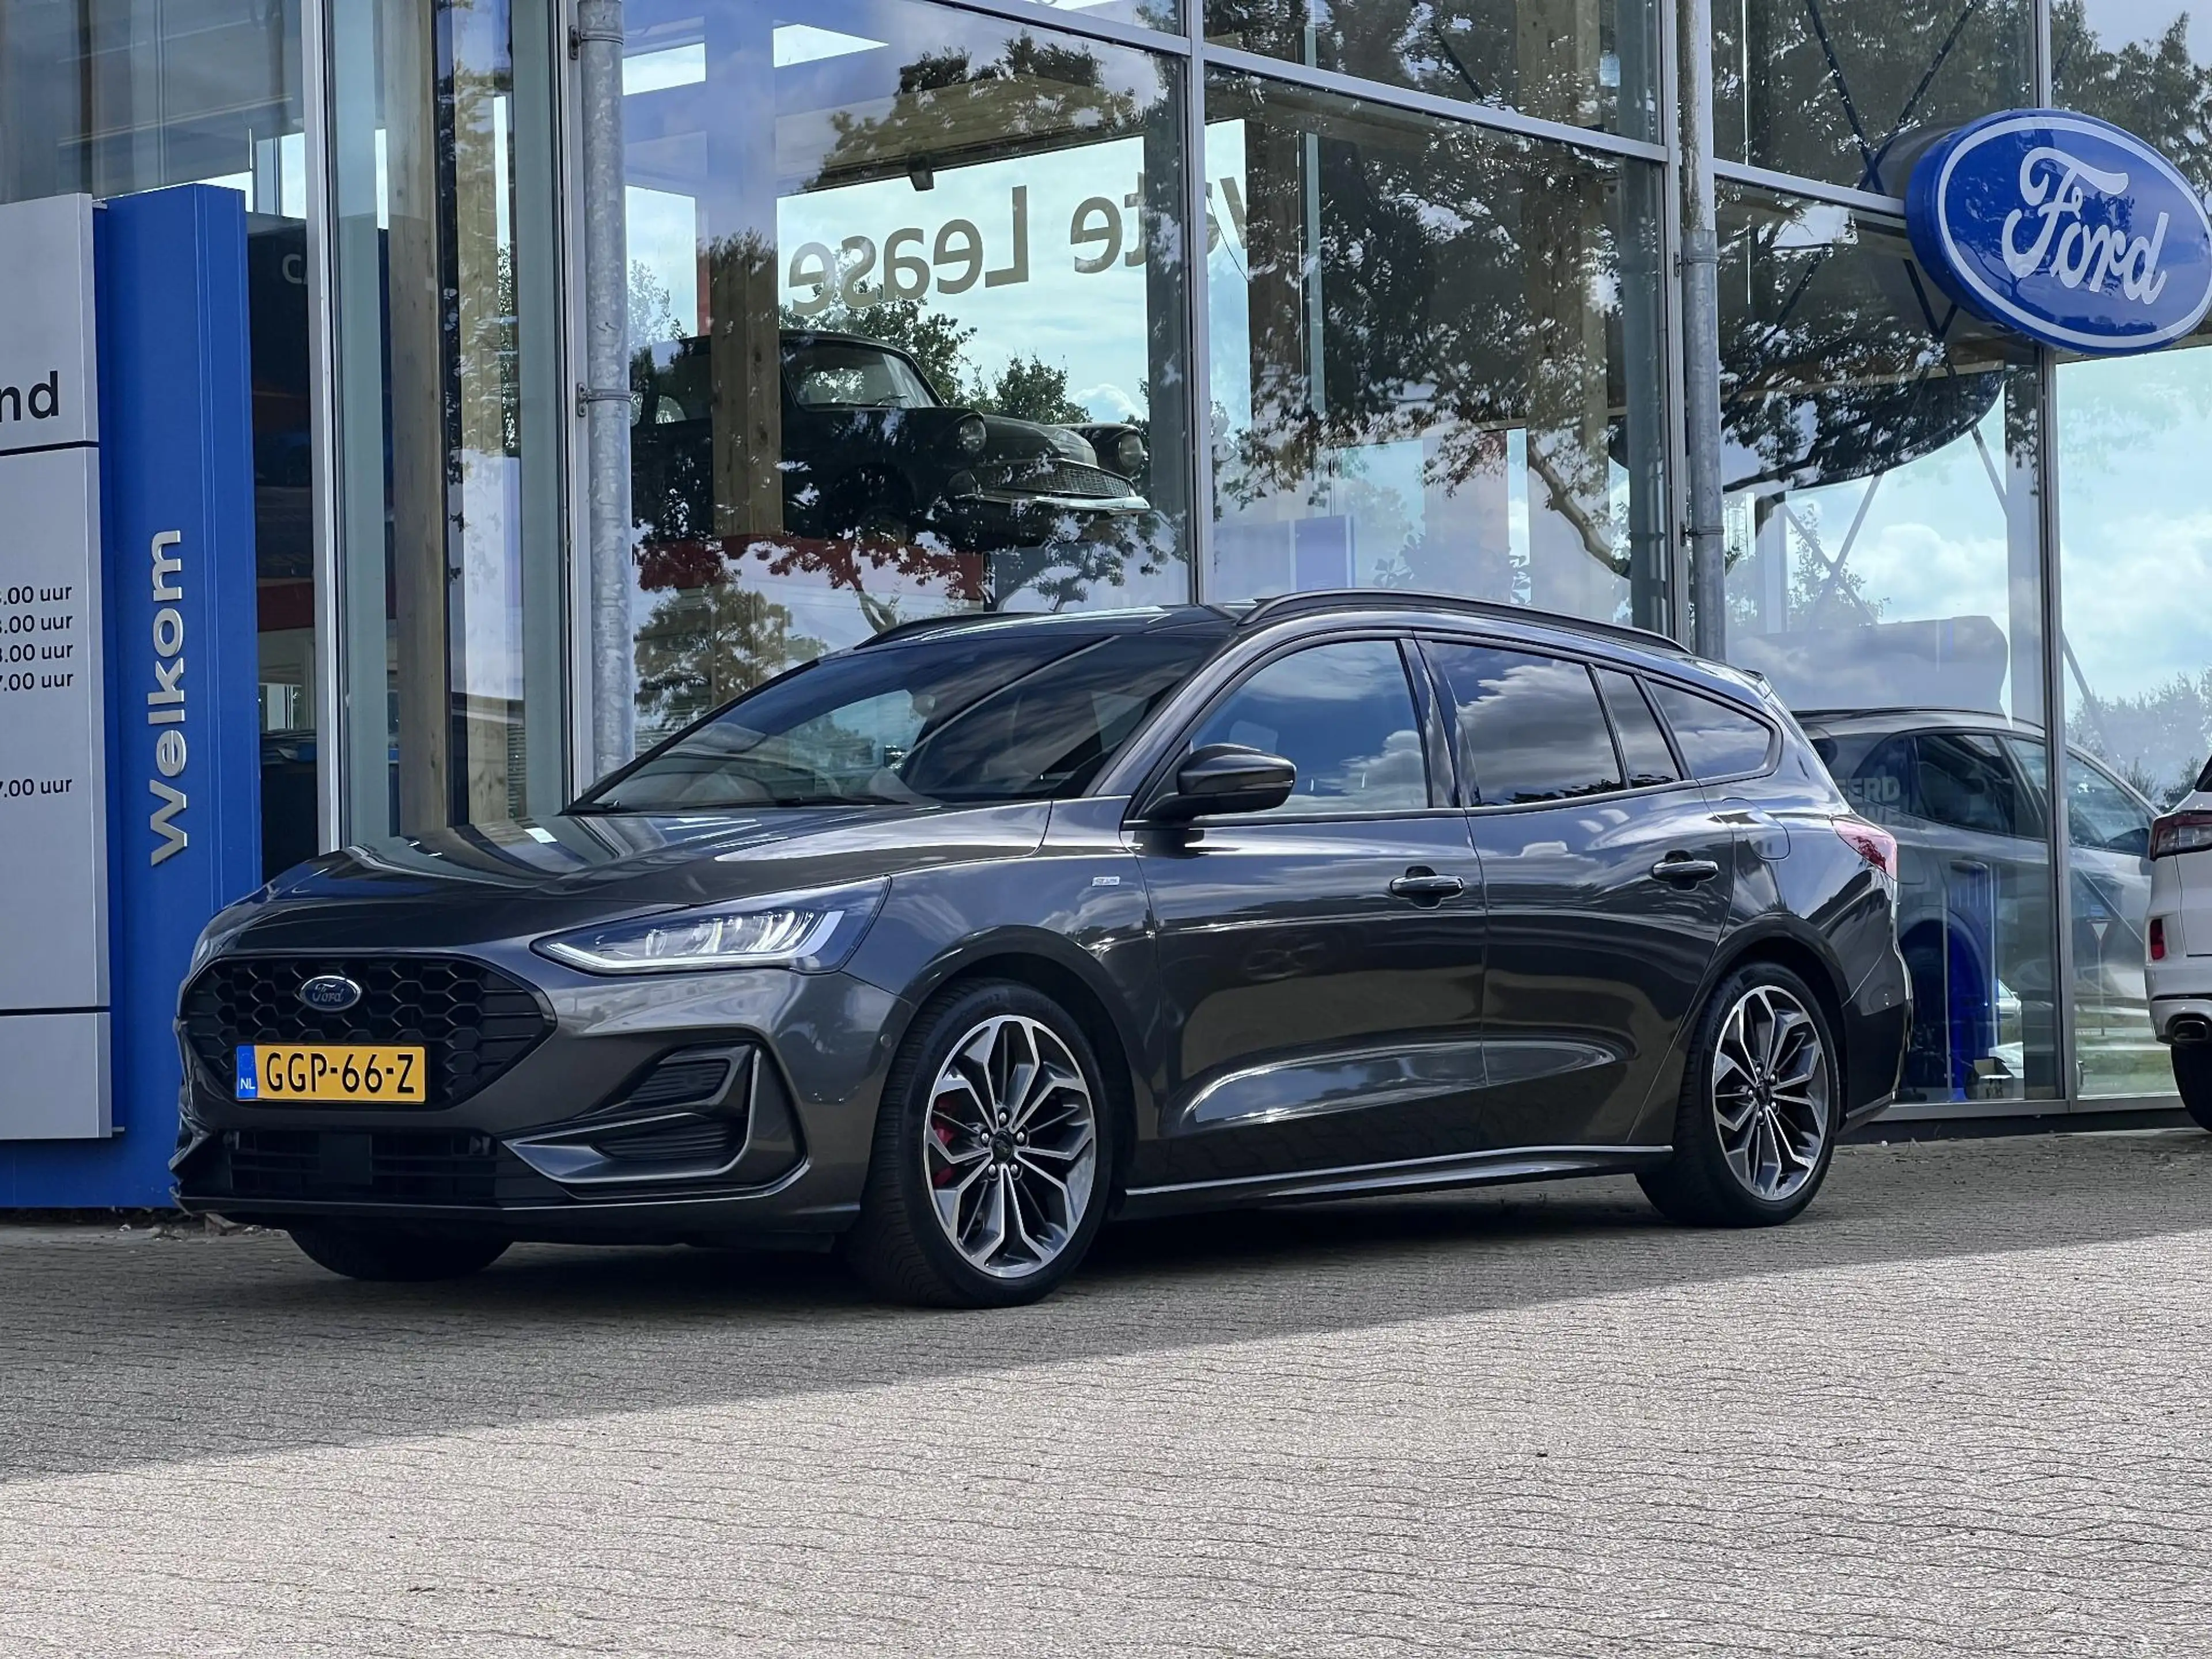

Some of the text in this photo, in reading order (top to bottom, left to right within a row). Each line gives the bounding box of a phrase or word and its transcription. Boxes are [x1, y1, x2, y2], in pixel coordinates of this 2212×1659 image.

[2002, 147, 2169, 304] Ford
[0, 586, 72, 605] .00 uur
[0, 615, 73, 634] .00 uur
[0, 643, 74, 663] .00 uur
[41, 674, 74, 688] uur
[147, 529, 188, 866] Welkom
[41, 779, 72, 794] uur
[312, 983, 345, 1003] Ford
[267, 1052, 415, 1094] GGP-66-Z
[240, 1078, 256, 1090] NL
